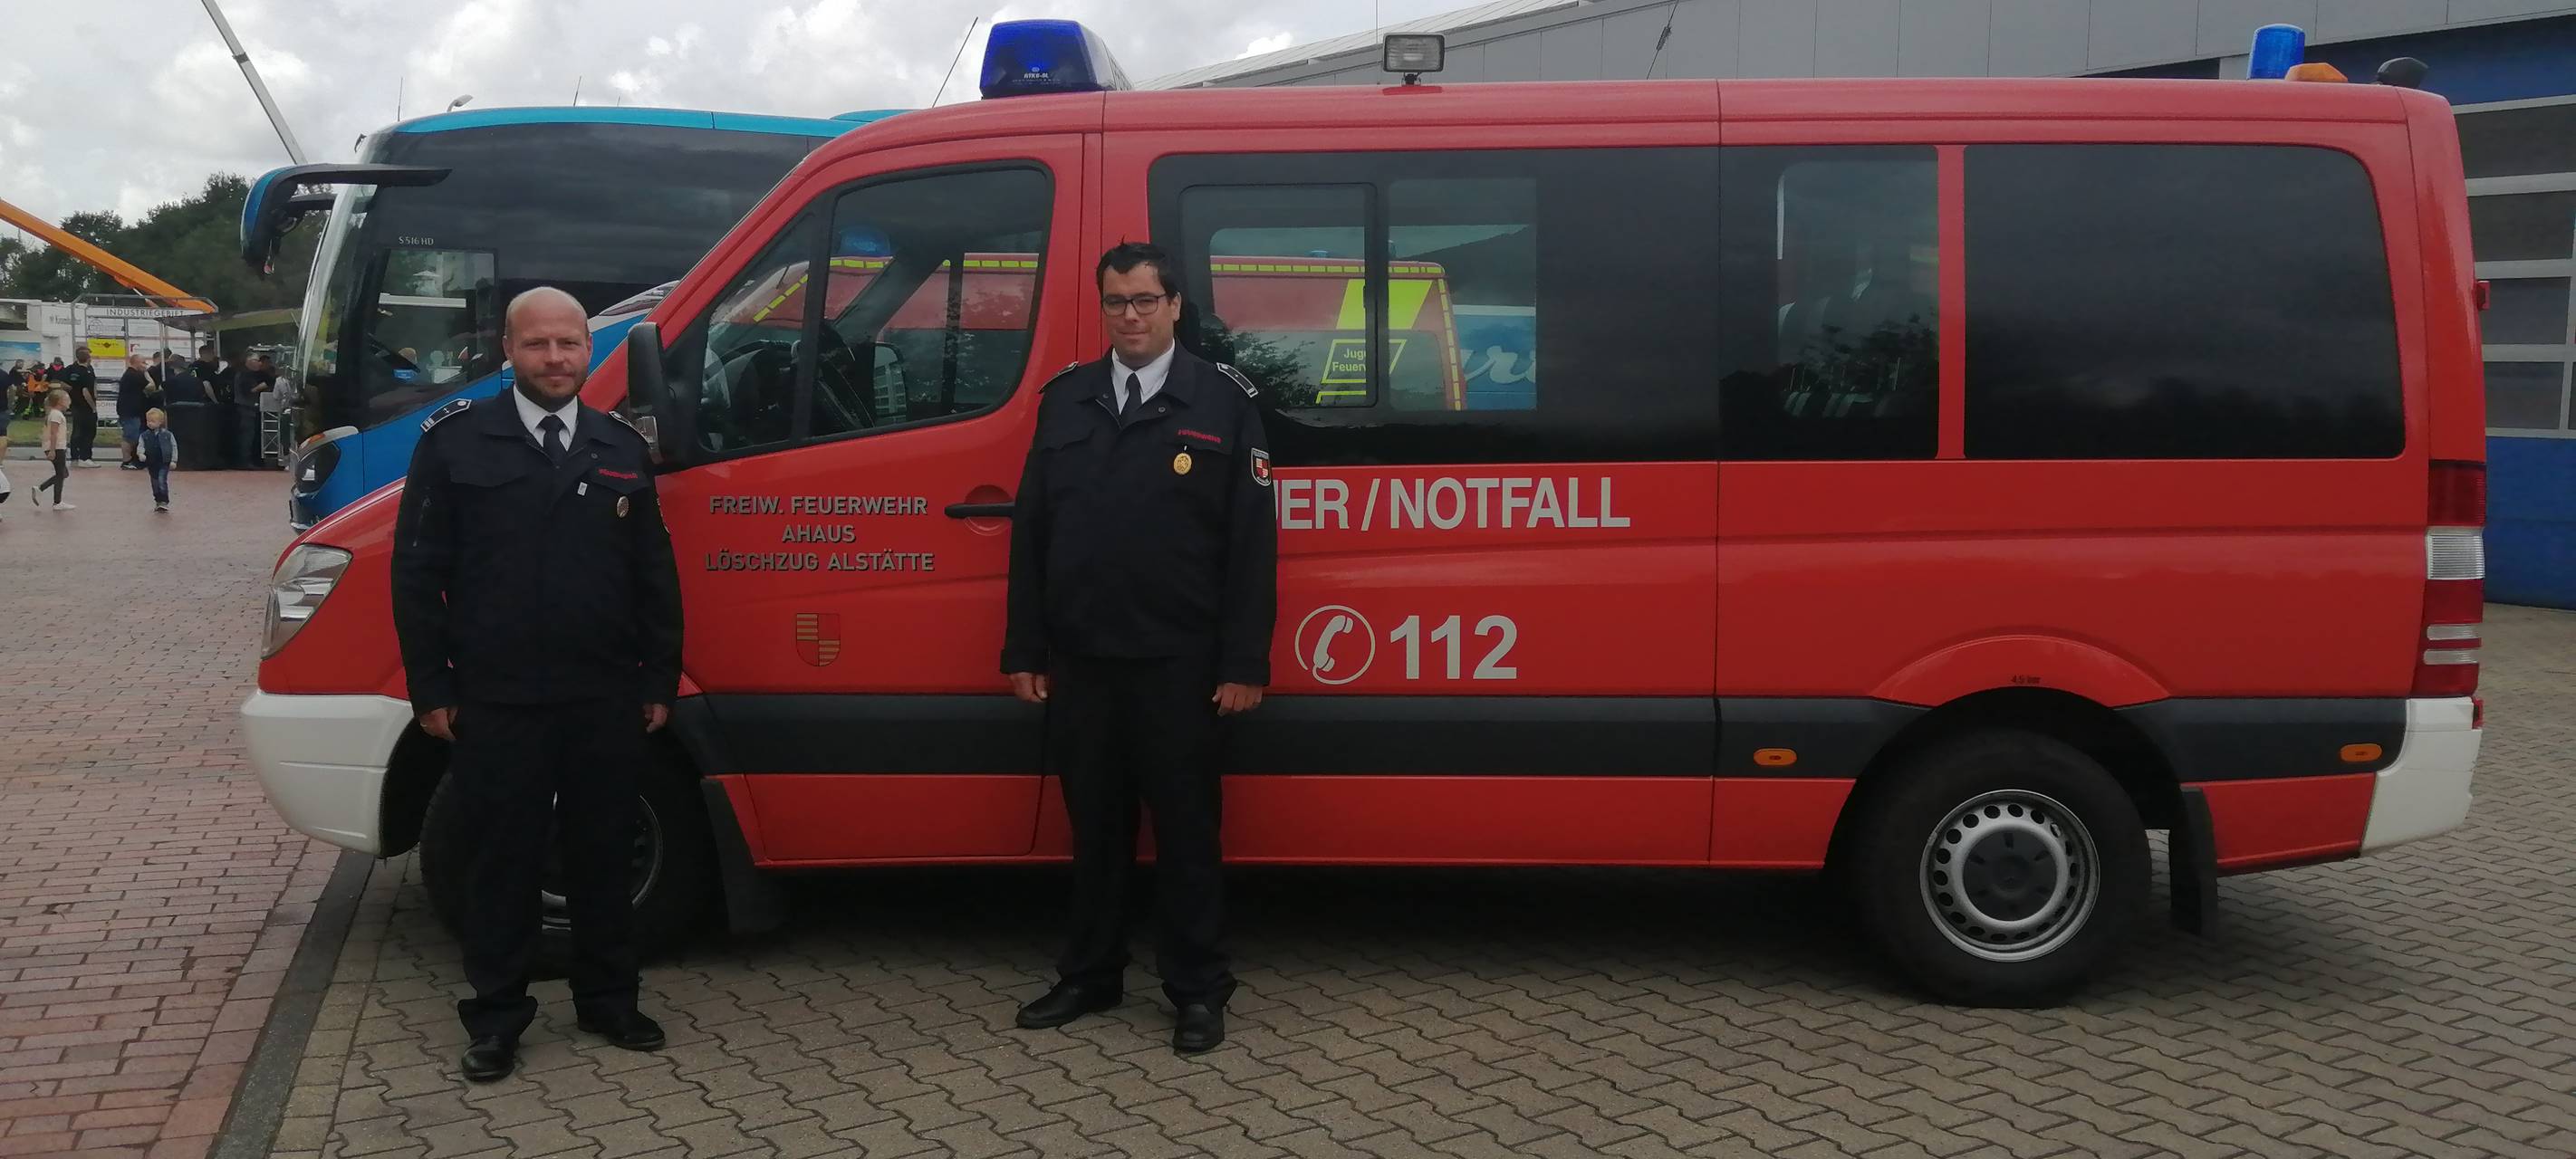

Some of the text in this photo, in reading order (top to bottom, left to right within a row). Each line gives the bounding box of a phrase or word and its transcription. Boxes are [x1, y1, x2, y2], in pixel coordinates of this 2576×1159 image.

[405, 236, 419, 244] 516
[420, 237, 434, 245] HD
[709, 496, 928, 515] FREIW. FEUERWEHR
[1273, 477, 1630, 532] ER / NOTFALL
[781, 524, 856, 543] AHAUS
[705, 548, 935, 571] LÖSCHZUG ALSTÄTTE
[1390, 615, 1518, 680] 112
